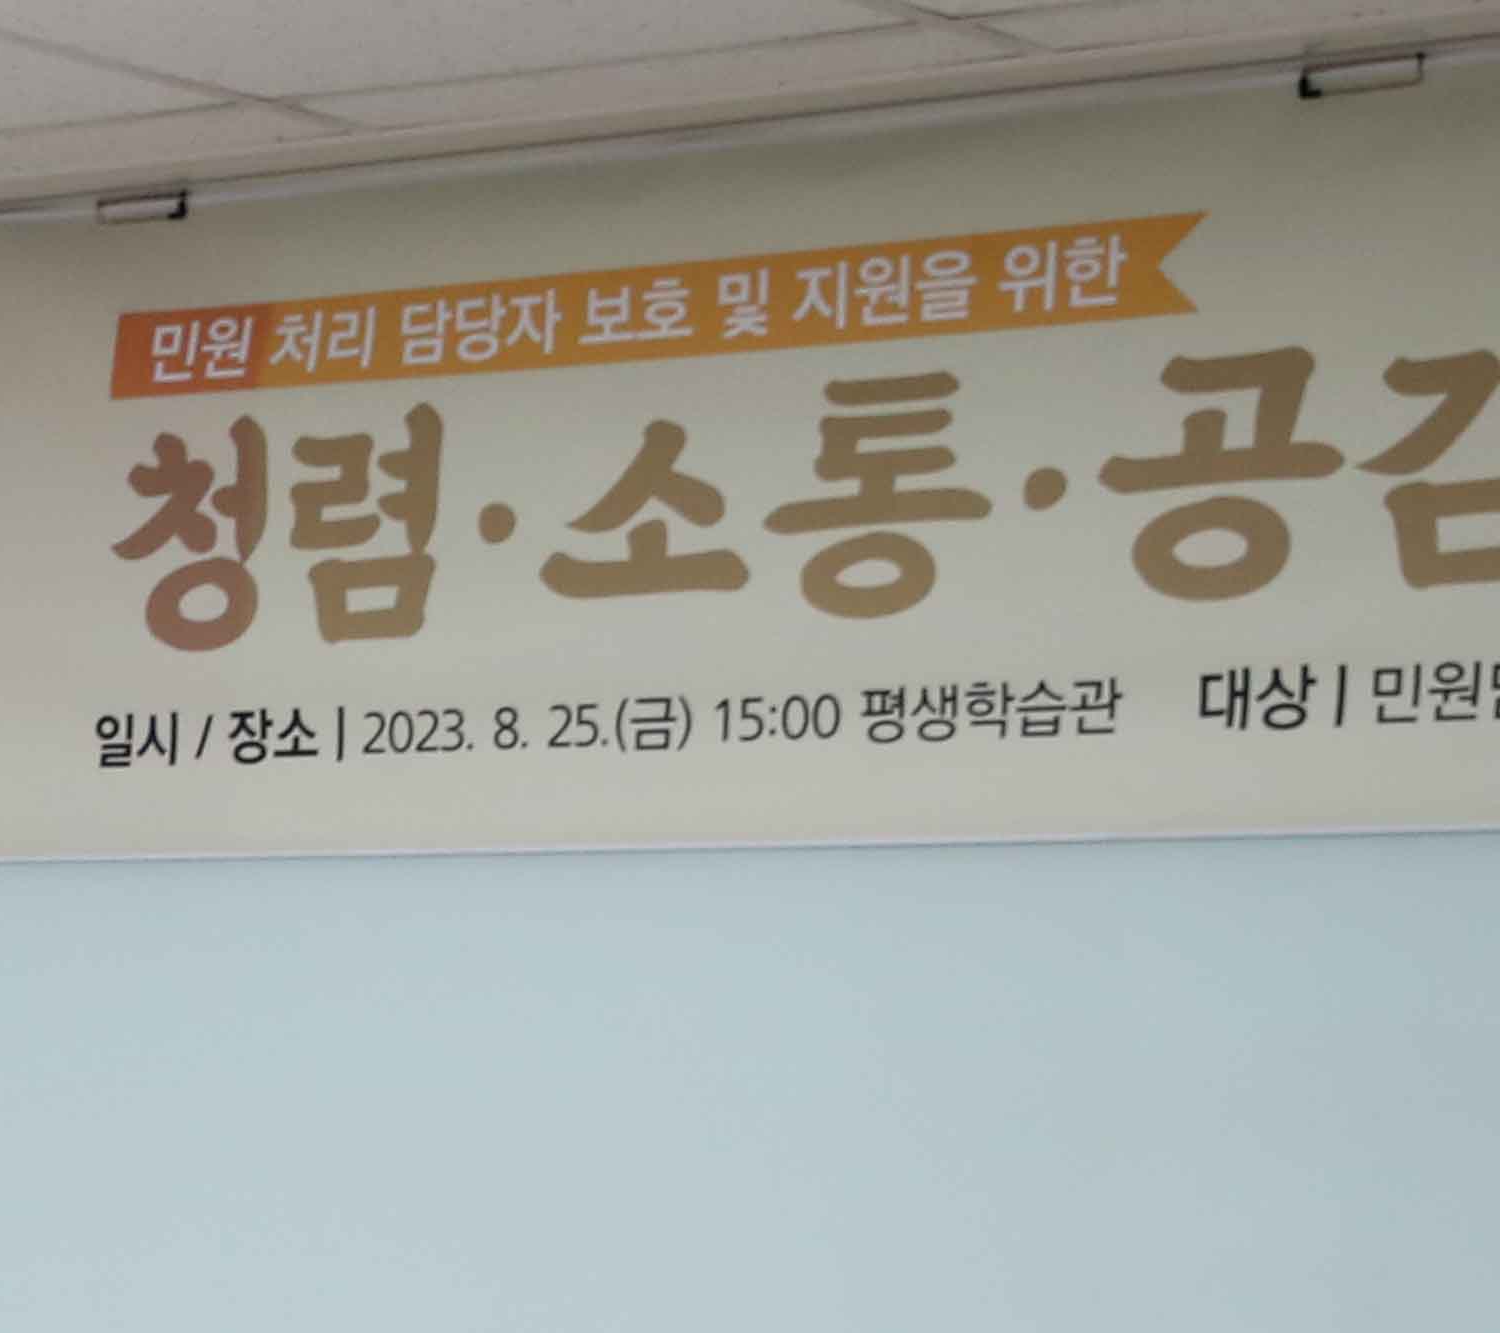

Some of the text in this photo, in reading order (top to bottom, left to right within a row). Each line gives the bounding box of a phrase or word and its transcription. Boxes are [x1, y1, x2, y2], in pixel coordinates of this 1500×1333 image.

[153, 235, 1127, 383] 민원 처리 담당자 보호 및 지원을 위한
[96, 712, 178, 767] 일시
[228, 708, 318, 764] 장소
[363, 709, 473, 754] 2023.
[494, 707, 527, 749] 8.
[716, 694, 840, 741] 15:00
[862, 678, 1123, 743] 평생학습관
[1200, 664, 1317, 730] 대상
[1373, 661, 1500, 723] 민원
